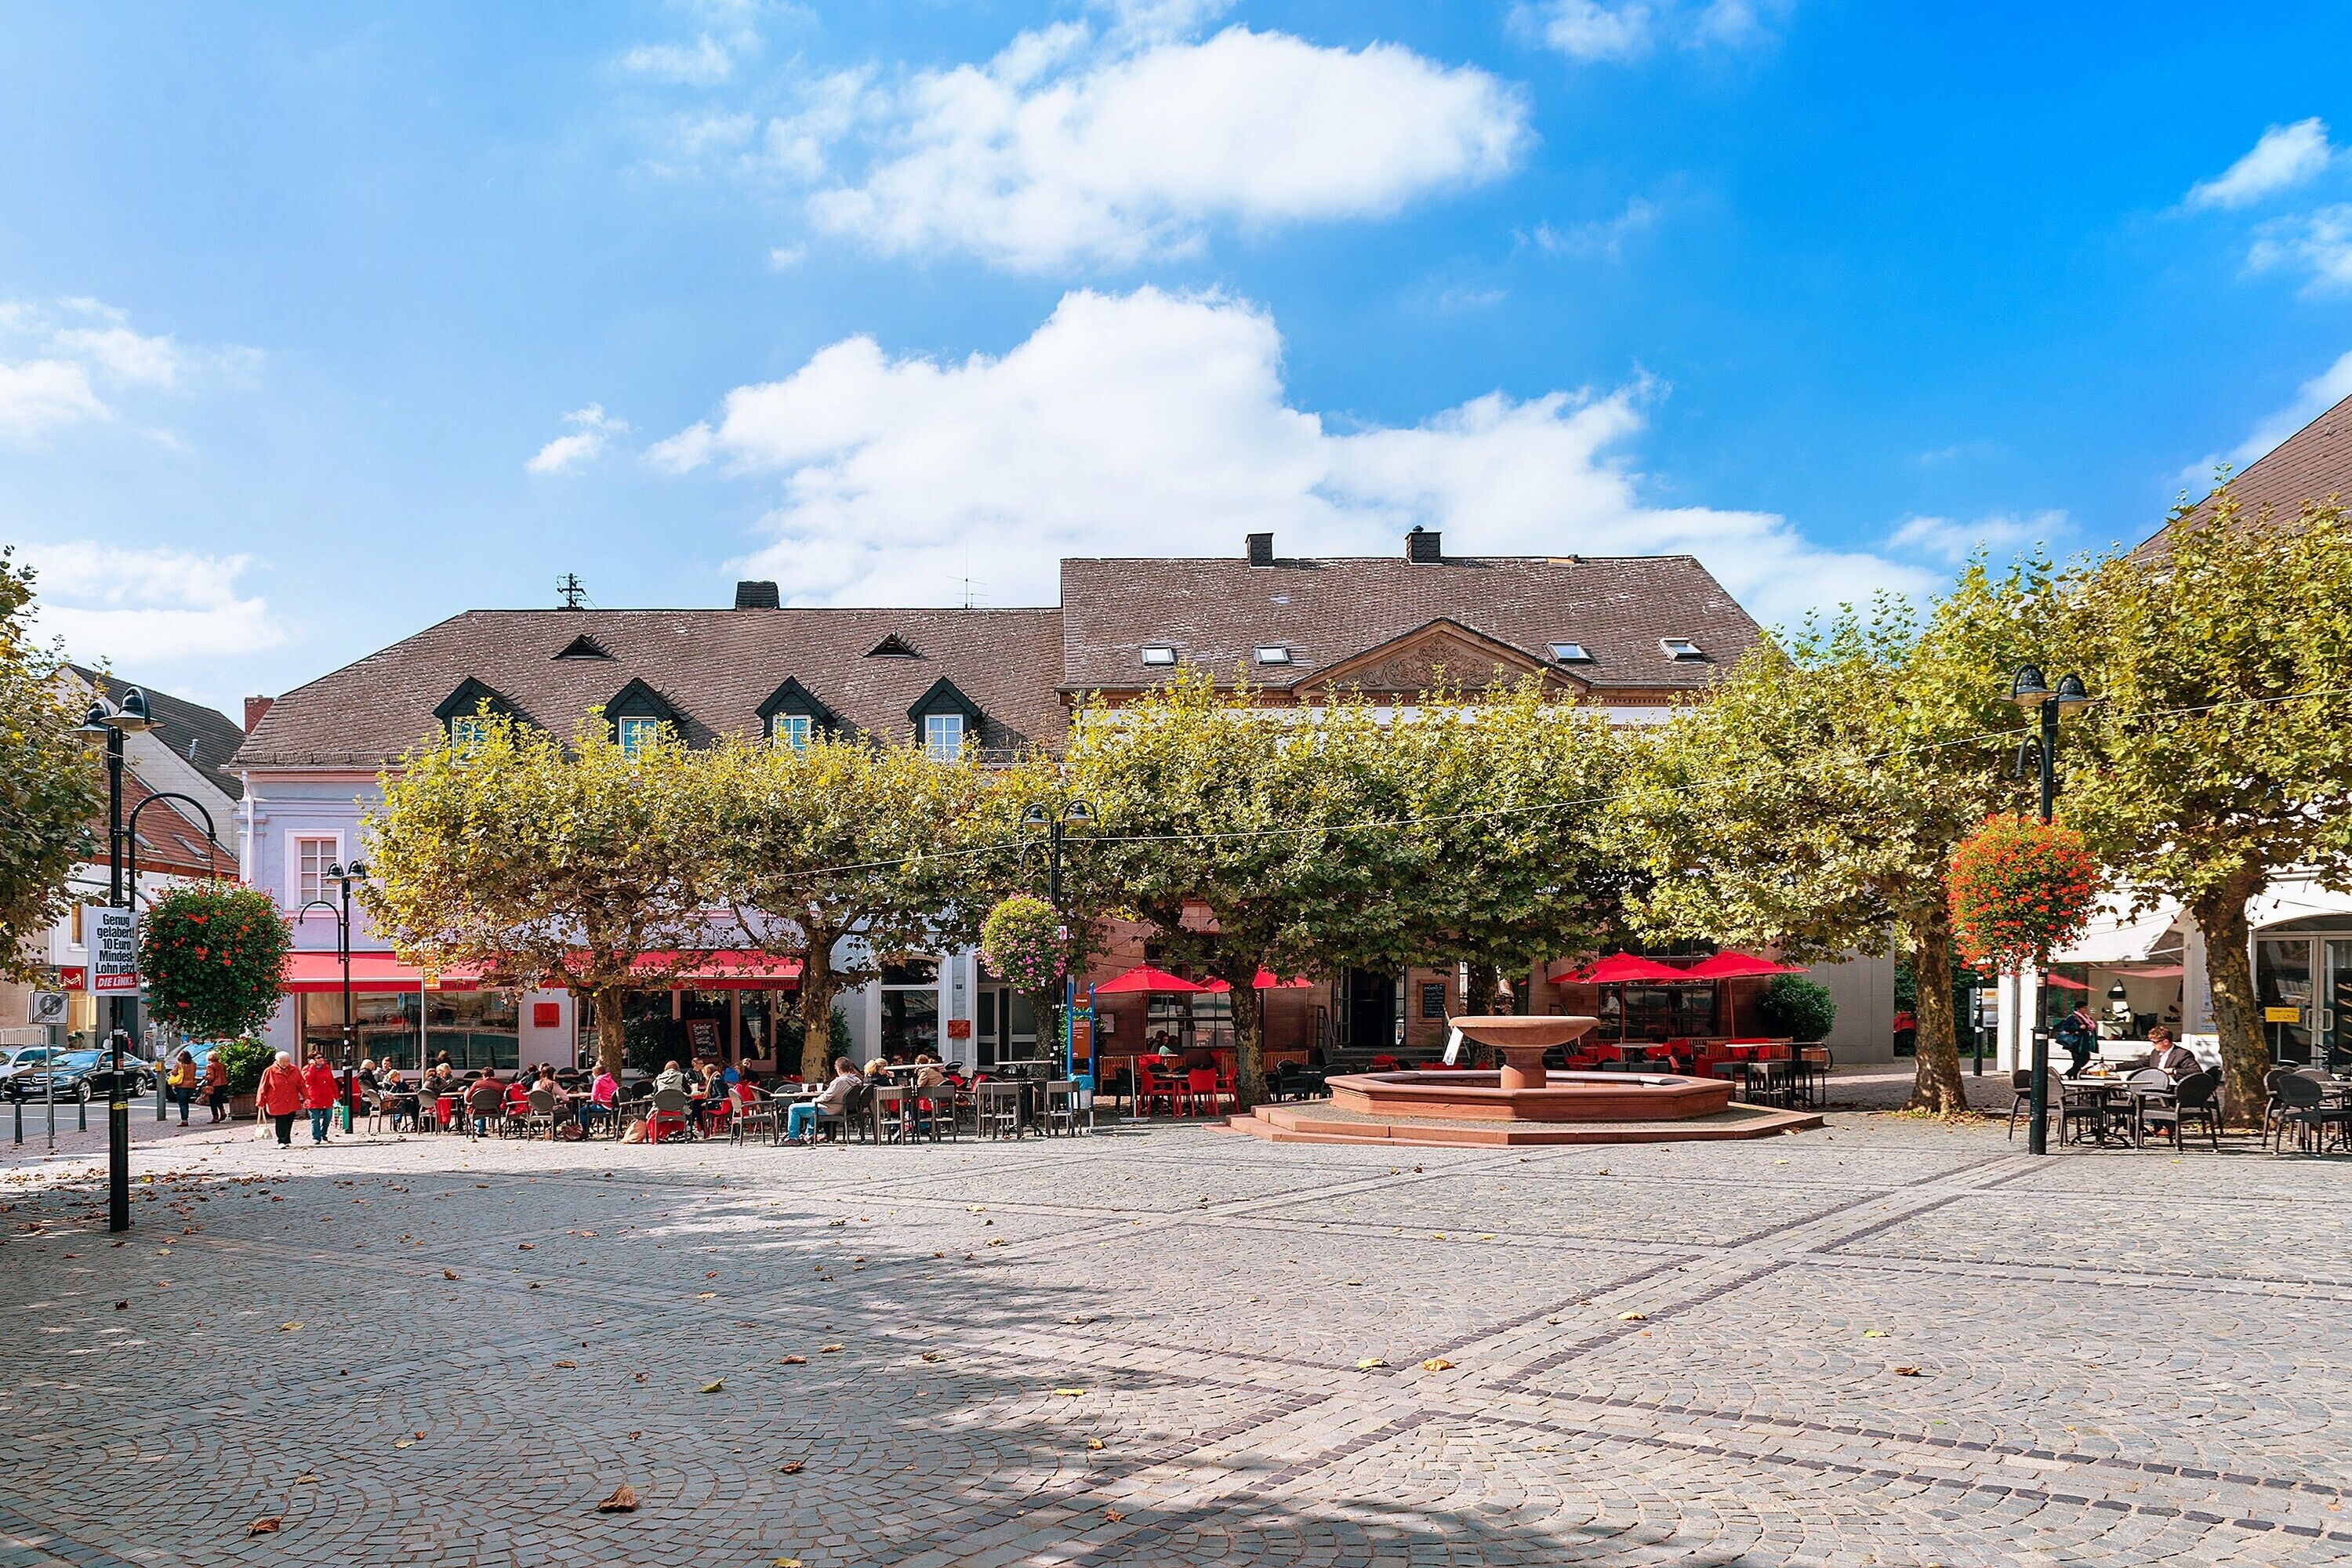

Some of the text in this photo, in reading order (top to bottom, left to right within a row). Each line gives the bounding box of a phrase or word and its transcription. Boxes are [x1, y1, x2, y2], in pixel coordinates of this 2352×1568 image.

[103, 913, 130, 927] Genug
[96, 926, 135, 938] gelabert!
[102, 938, 131, 950] 10 Euro
[99, 949, 134, 963] Mindest-
[96, 962, 136, 975] Lohn jetzt.
[97, 977, 112, 987] DIE
